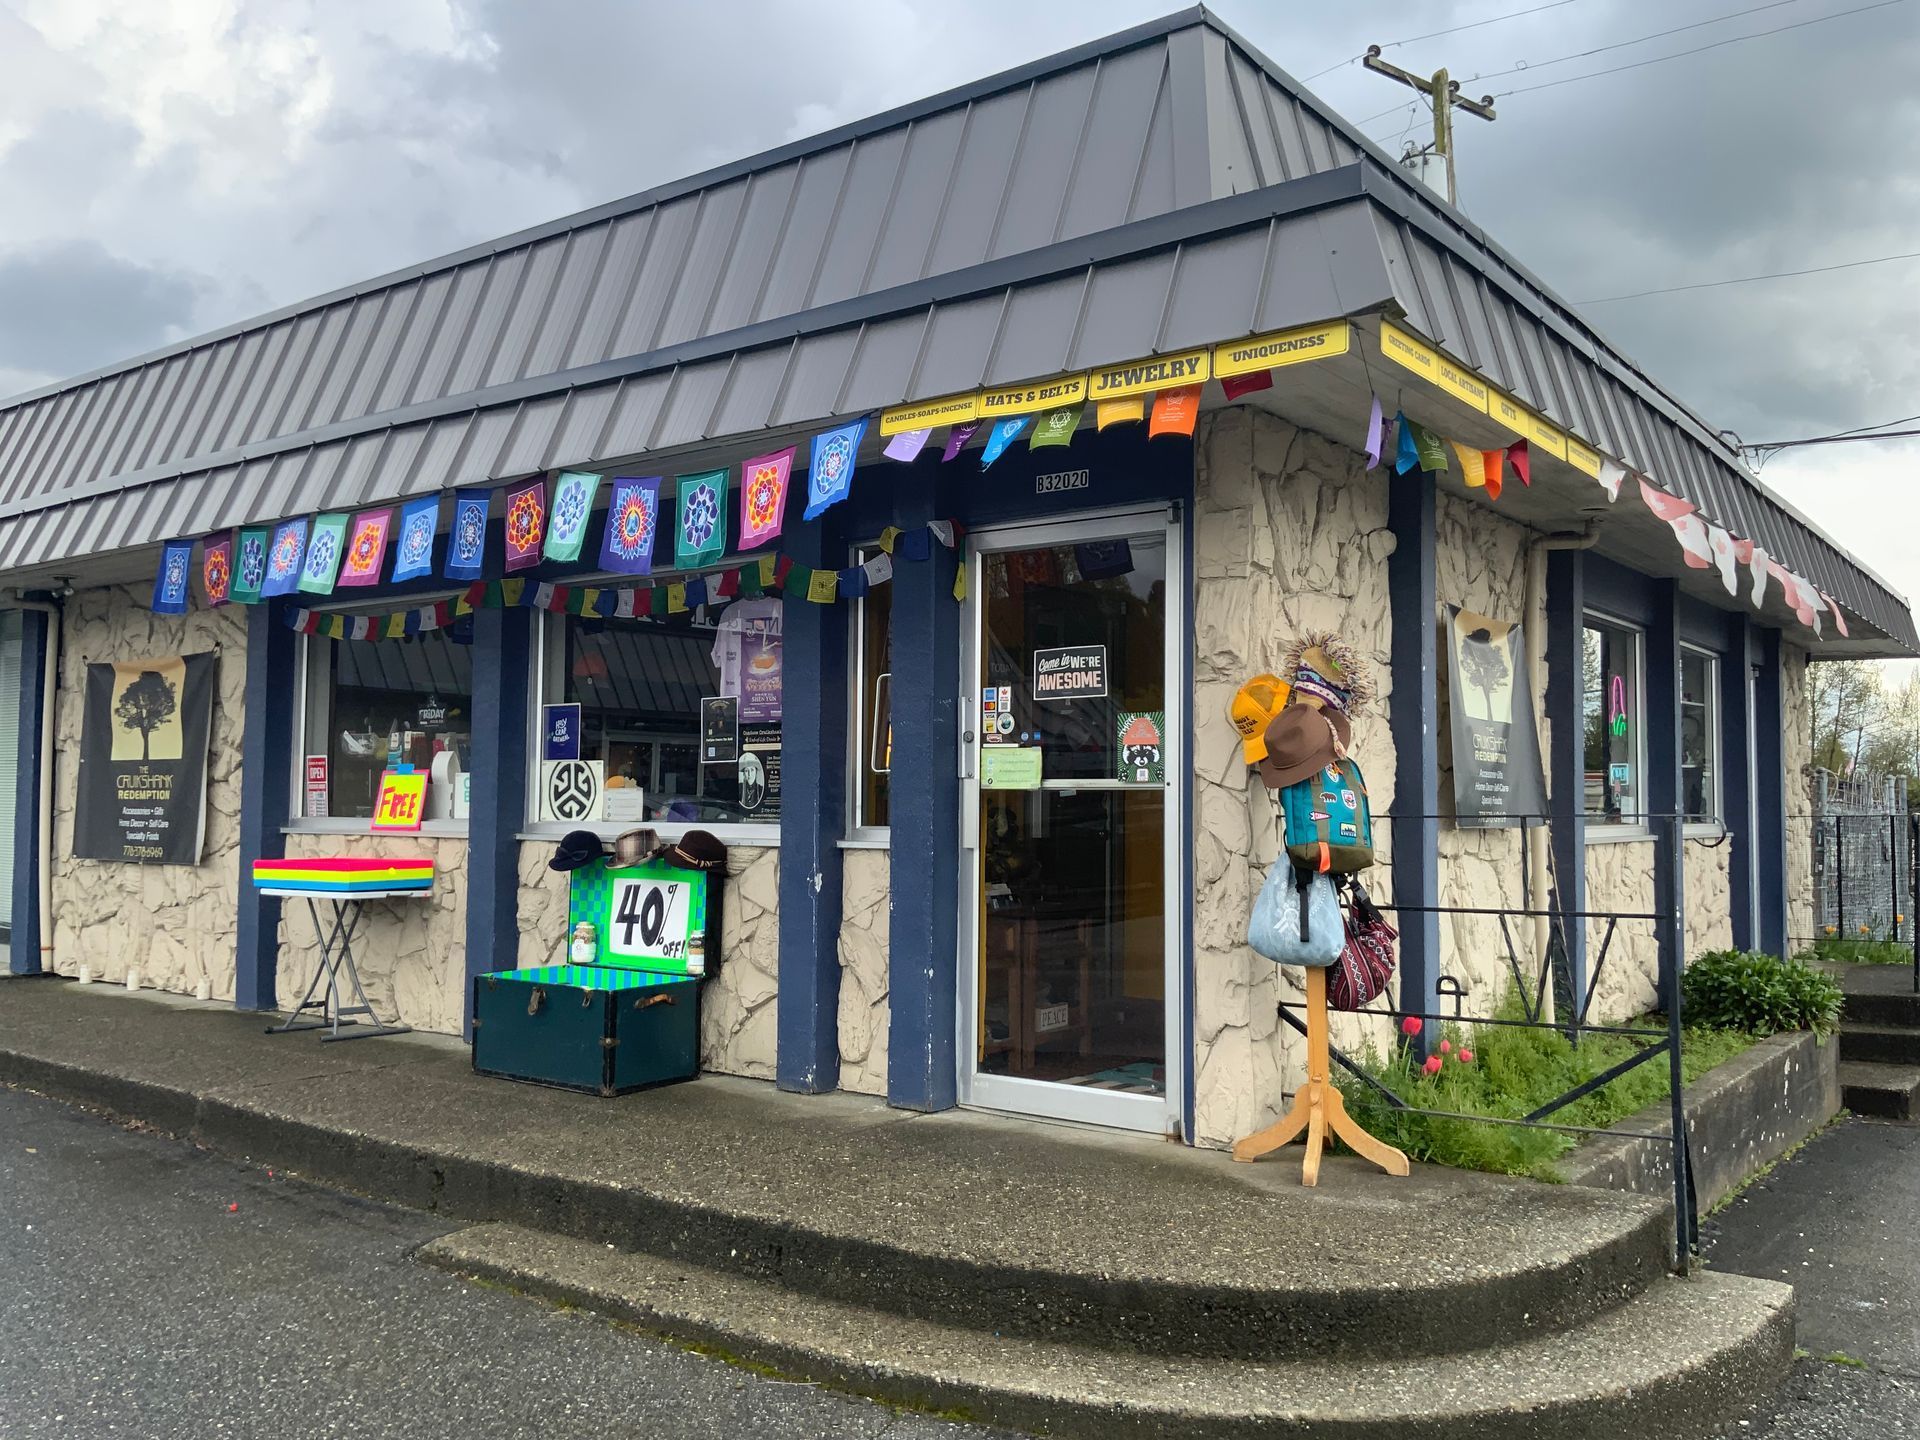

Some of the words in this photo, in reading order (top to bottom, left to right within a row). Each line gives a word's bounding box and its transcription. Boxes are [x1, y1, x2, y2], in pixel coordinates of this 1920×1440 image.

[1097, 357, 1201, 390] JEWELRY
[1441, 366, 1457, 384] LOCAL
[985, 393, 1023, 407] HATS
[1026, 391, 1035, 402] &
[1039, 381, 1080, 400] BELTS
[1037, 470, 1088, 492] B32020
[1038, 658, 1059, 672] Come
[1060, 653, 1070, 667] in
[1038, 670, 1102, 691] AWESOME
[139, 765, 149, 774] THE
[309, 767, 325, 779] OPEN
[117, 789, 171, 800] REDEMPTION
[378, 786, 418, 820] FREE
[615, 883, 679, 947] 40%
[662, 940, 686, 959] OFF!
[1041, 1007, 1067, 1027] PEACE
